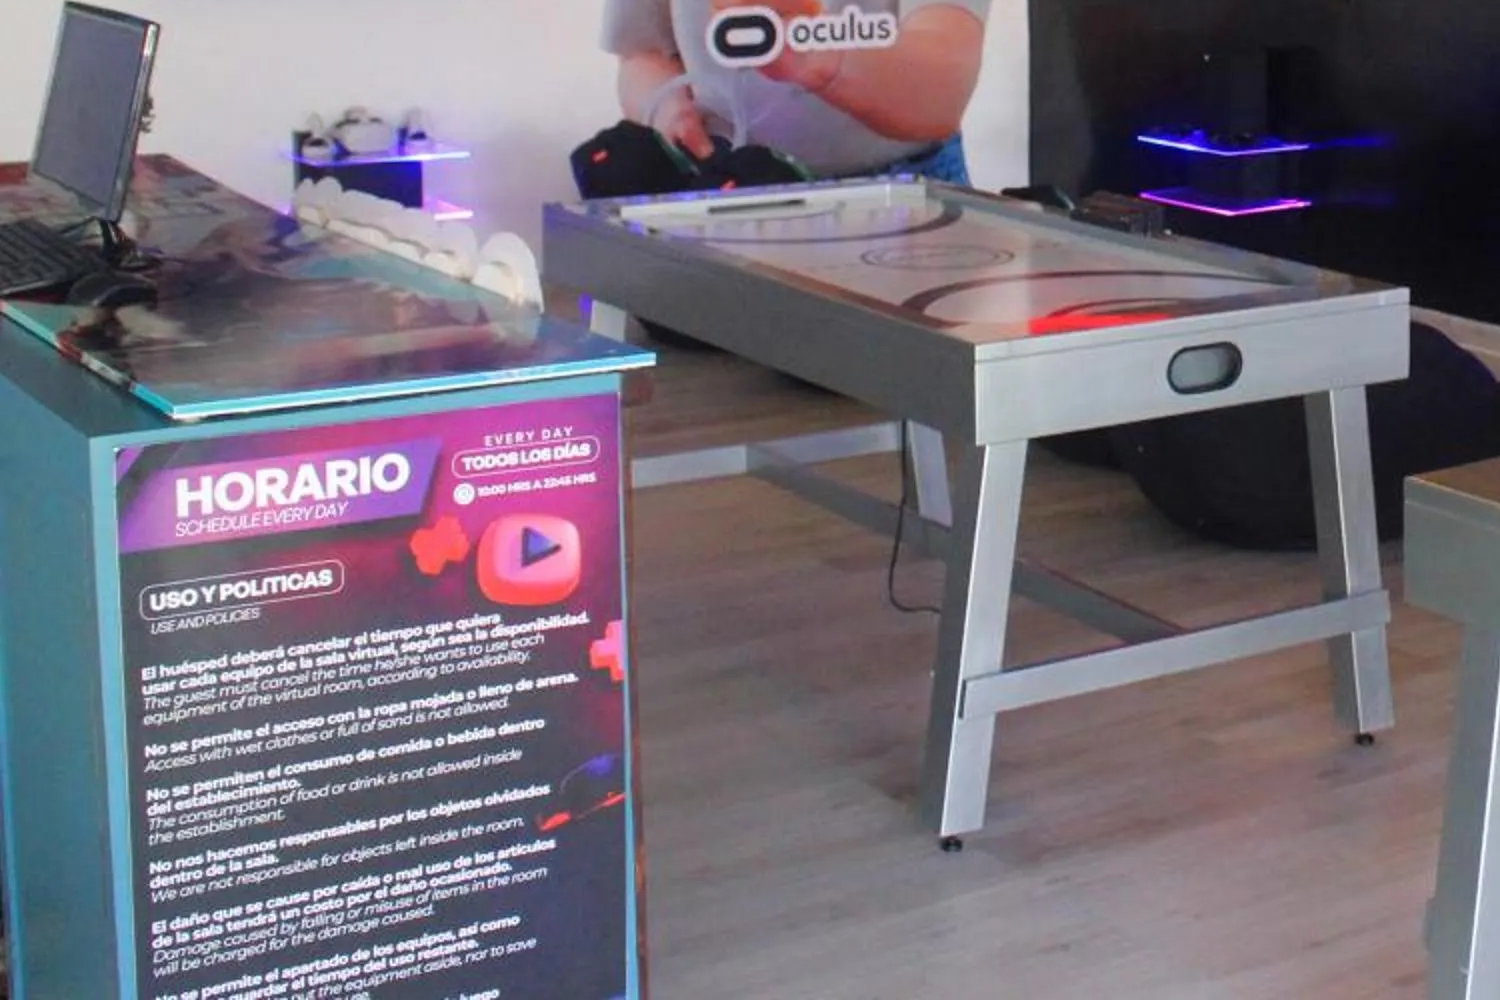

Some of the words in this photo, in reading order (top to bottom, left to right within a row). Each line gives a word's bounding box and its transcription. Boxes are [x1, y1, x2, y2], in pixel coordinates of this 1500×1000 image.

[793, 12, 892, 44] oculus
[484, 430, 535, 446] EVERY
[541, 426, 573, 440] DAY
[462, 451, 519, 471] TODOS
[521, 449, 551, 463] LOS
[553, 441, 591, 459] DÍAS
[175, 453, 411, 518] HORARIO
[533, 480, 542, 489] A
[175, 513, 261, 537] SCHEDULE
[263, 507, 315, 527] EVERY
[315, 501, 349, 519] DAY
[150, 589, 197, 611] USO
[202, 585, 218, 603] Y
[150, 620, 176, 635] USE
[176, 616, 205, 629] AND
[205, 607, 260, 626] POLICIES
[141, 666, 156, 680] El
[159, 654, 227, 677] huésped
[231, 645, 284, 666] deberá
[288, 636, 351, 656] cancelar
[370, 626, 422, 643] tiempo
[426, 621, 452, 637] que
[456, 613, 500, 632] quiera
[141, 680, 176, 694] usar
[179, 671, 217, 688] cada
[220, 664, 273, 683] equipo
[277, 659, 296, 672] de
[315, 651, 344, 666] sala
[348, 642, 397, 661] virtual,
[401, 635, 444, 653] según
[448, 632, 472, 645] sea
[489, 611, 589, 638] disponibilidad.
[144, 743, 166, 757] No
[170, 741, 187, 752] se
[192, 729, 252, 752] permite
[273, 717, 323, 734] acceso
[327, 711, 354, 725] con
[374, 702, 407, 717] ropa
[410, 691, 464, 710] mojada
[479, 684, 512, 699] lleno
[515, 679, 532, 692] de
[536, 673, 578, 688] arena.
[145, 787, 168, 801] No
[171, 784, 189, 796] se
[193, 771, 263, 795] permiten
[284, 754, 352, 776] consumo
[356, 749, 374, 762] de
[378, 738, 432, 758] comida
[447, 727, 495, 746] bebida
[499, 719, 544, 736] dentro
[147, 799, 171, 816] del
[175, 778, 301, 811] establecimiento.
[149, 860, 171, 874] No
[175, 854, 203, 869] nos
[207, 840, 276, 862] hacemos
[280, 819, 375, 847] responsables
[379, 813, 402, 830] por
[407, 808, 426, 822] los
[430, 797, 481, 816] objetos
[485, 783, 550, 805] olvidados
[149, 869, 202, 888] dentro
[206, 863, 224, 876] de
[151, 919, 166, 934] El
[169, 912, 209, 930] daño
[213, 906, 242, 923] que
[246, 901, 263, 913] se
[266, 891, 309, 909] cause
[313, 885, 337, 902] por
[396, 863, 422, 881] mal
[425, 861, 450, 875] uso
[454, 855, 471, 868] de
[475, 851, 494, 864] los
[152, 934, 172, 948] de
[192, 923, 222, 939] sala
[226, 909, 276, 932] tendrá
[280, 907, 300, 920] un
[304, 897, 343, 915] costo
[346, 891, 371, 908] por
[391, 878, 426, 895] daño
[429, 860, 512, 887] ocasionado.
